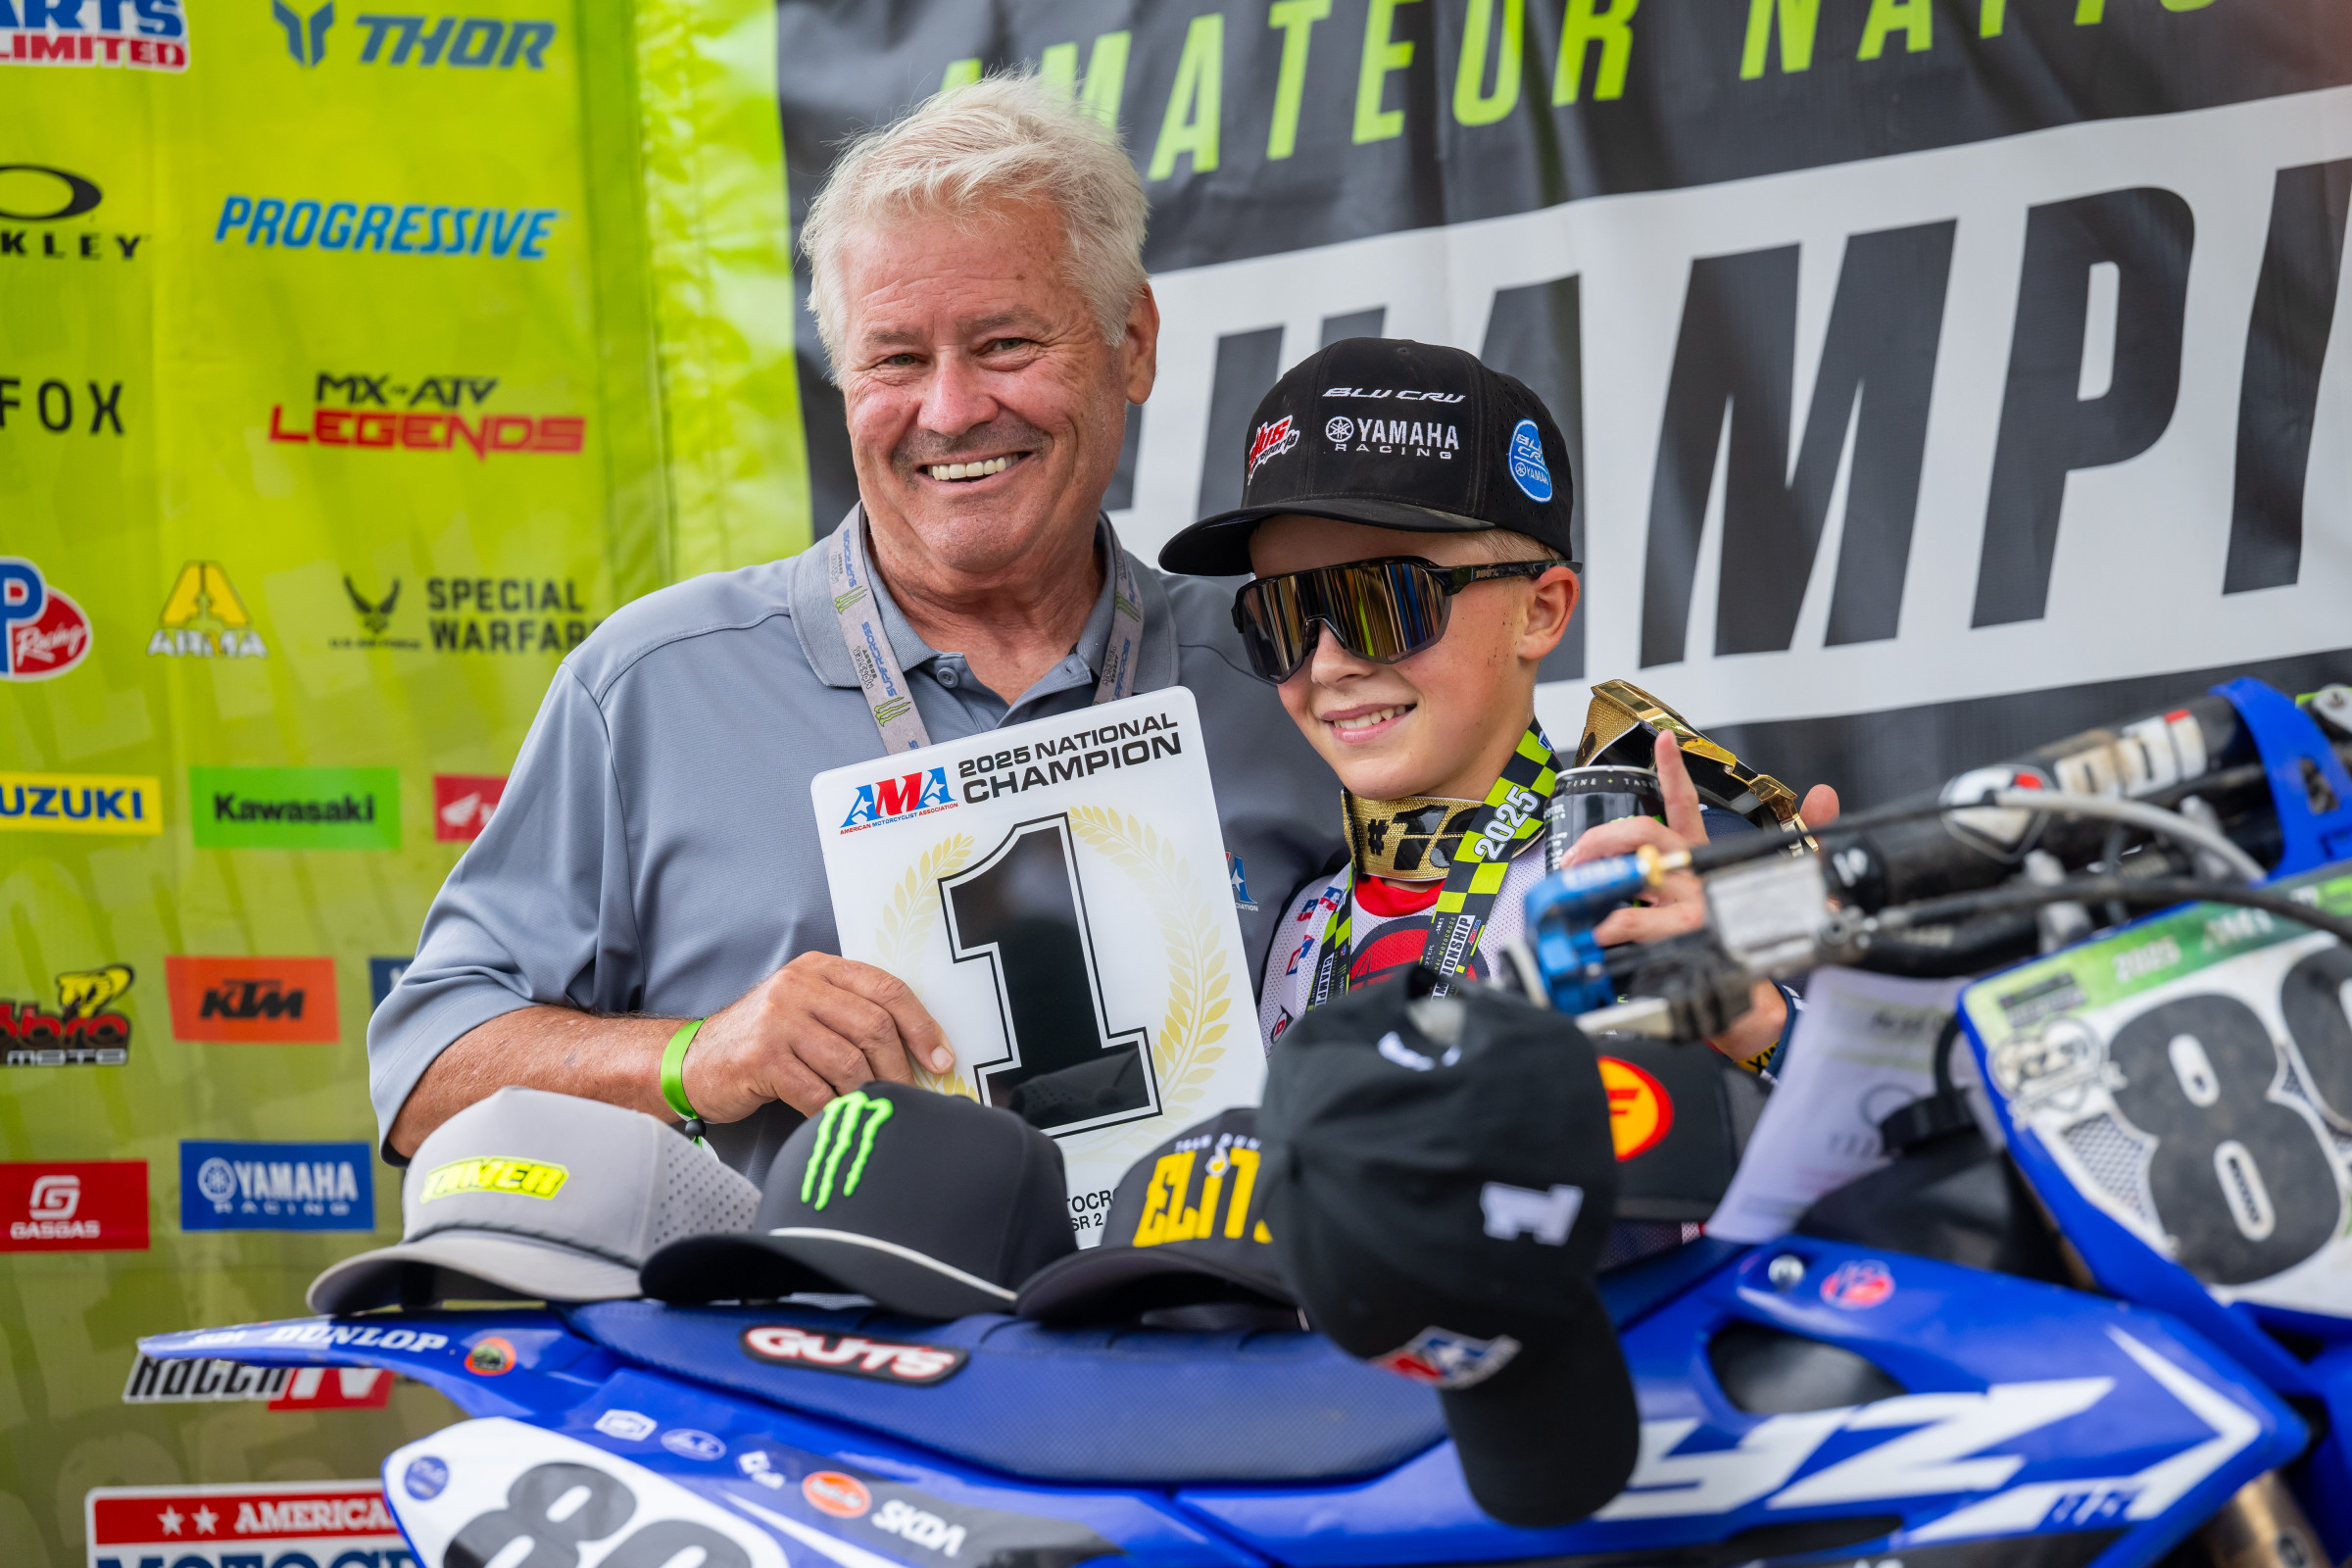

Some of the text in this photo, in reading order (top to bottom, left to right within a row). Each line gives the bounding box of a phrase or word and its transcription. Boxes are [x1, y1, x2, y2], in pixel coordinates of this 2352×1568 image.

[0, 34, 185, 67] IMITED
[355, 15, 556, 70] THOR
[215, 196, 558, 258] PROGRESSIVE
[0, 378, 124, 436] FOX
[1323, 387, 1466, 404] BLU CRU
[269, 404, 587, 462] LEGENDS
[1335, 443, 1452, 460] RACING
[1357, 417, 1459, 450] YAMAHA
[426, 578, 585, 612] SPECIAL
[427, 618, 606, 653] WARFAR
[957, 712, 1179, 779] 2025 NATIONAL
[962, 731, 1183, 805] CHAMPION
[213, 793, 375, 824] Kawasaki
[839, 766, 957, 828] AMA
[840, 802, 958, 836] AMERICAN MOTORCYCLIST ASSOCIATION
[1473, 785, 1541, 861] 2025
[937, 811, 1163, 1140] 1
[199, 979, 307, 1020] KTM
[233, 1160, 360, 1202] YAMAHA
[213, 1201, 351, 1216] RACING
[10, 1220, 101, 1240] GASGAS
[264, 1323, 449, 1353] DUNLOP
[744, 1326, 957, 1379] GUTS
